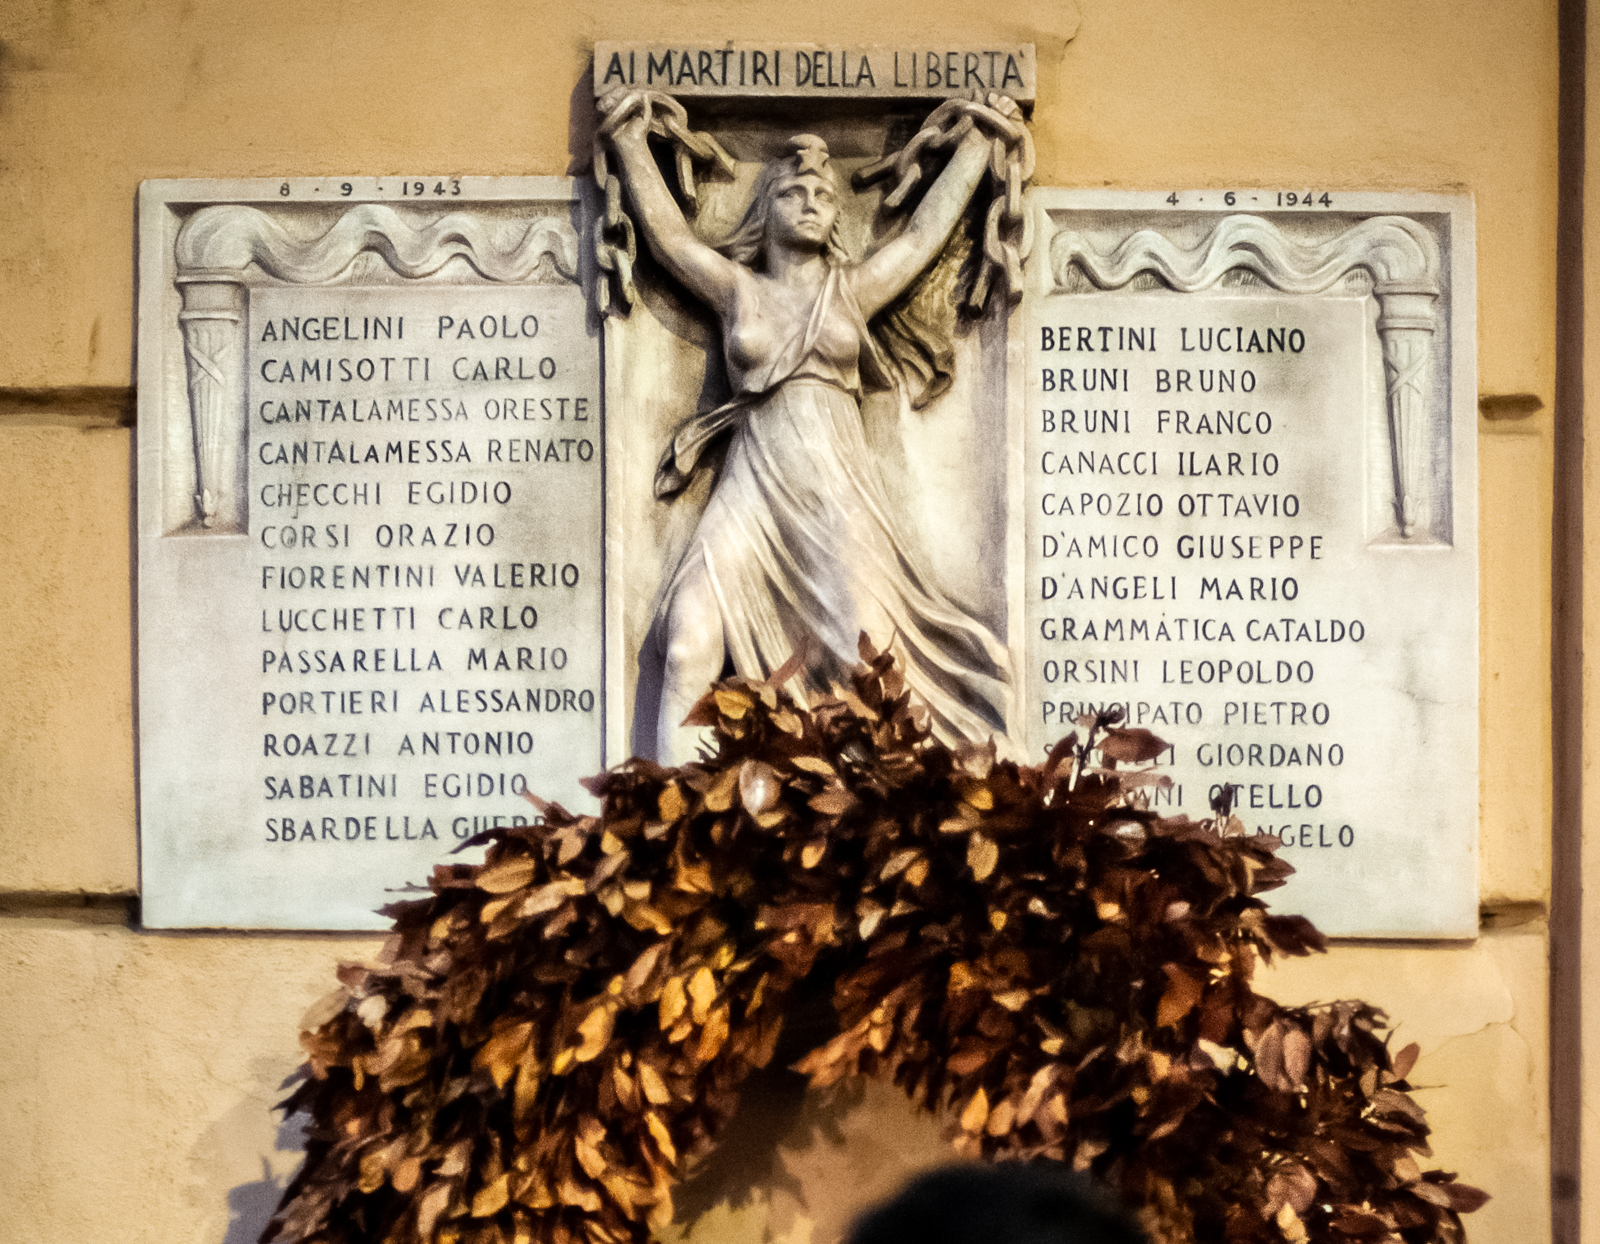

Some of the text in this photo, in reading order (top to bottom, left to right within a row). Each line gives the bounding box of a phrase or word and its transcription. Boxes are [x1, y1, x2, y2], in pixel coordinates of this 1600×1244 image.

[604, 50, 635, 86] AI
[647, 49, 781, 87] MARTIRI
[795, 49, 875, 88] DELLA
[280, 182, 290, 197] 8
[341, 182, 353, 197] 9
[403, 179, 461, 196] 1943
[1166, 191, 1179, 205] 4
[1224, 191, 1236, 206] 6
[1277, 192, 1332, 207] 1944
[261, 314, 539, 342] ANGELINI PAOLO
[1041, 326, 1305, 356] BERTINI LUCIANO
[260, 356, 557, 384] CAMISOTTI CARLO
[1042, 368, 1256, 394] BRUNI BRUNO
[259, 397, 589, 426] CANTALAMESSA ORESTE
[1042, 409, 1272, 436] BRUNI FRANCO
[259, 438, 594, 468] CANTALAMESSA RENATO
[1041, 451, 1279, 478] CANACCI ILARIO
[260, 481, 512, 511] CHECCHI EGIDIO
[1041, 492, 1300, 519] CAPOZIO OTTAVIO
[261, 523, 496, 550] CORSI ORAZIO
[1176, 534, 1323, 561] GIUSEPPE
[262, 562, 580, 591] FIORENTINI VALERIO
[1199, 576, 1299, 602] MARIO
[262, 605, 539, 635] LUCCHETTI CARLO
[1246, 618, 1365, 643] CATALDO
[262, 647, 568, 675] PASSARELLA MARIO
[1043, 659, 1314, 685] ORSINI LEOPOLDO
[262, 688, 595, 717] PORTIERI ALESSANDRO
[1224, 701, 1330, 726] PIETRO
[263, 731, 534, 758] ROAZZI ANTONIO
[1196, 743, 1344, 768] GIORDANO
[264, 772, 531, 802] SABATINI EGIDIO
[1208, 785, 1323, 808] OTELLO
[265, 816, 439, 843] SBARDELLA
